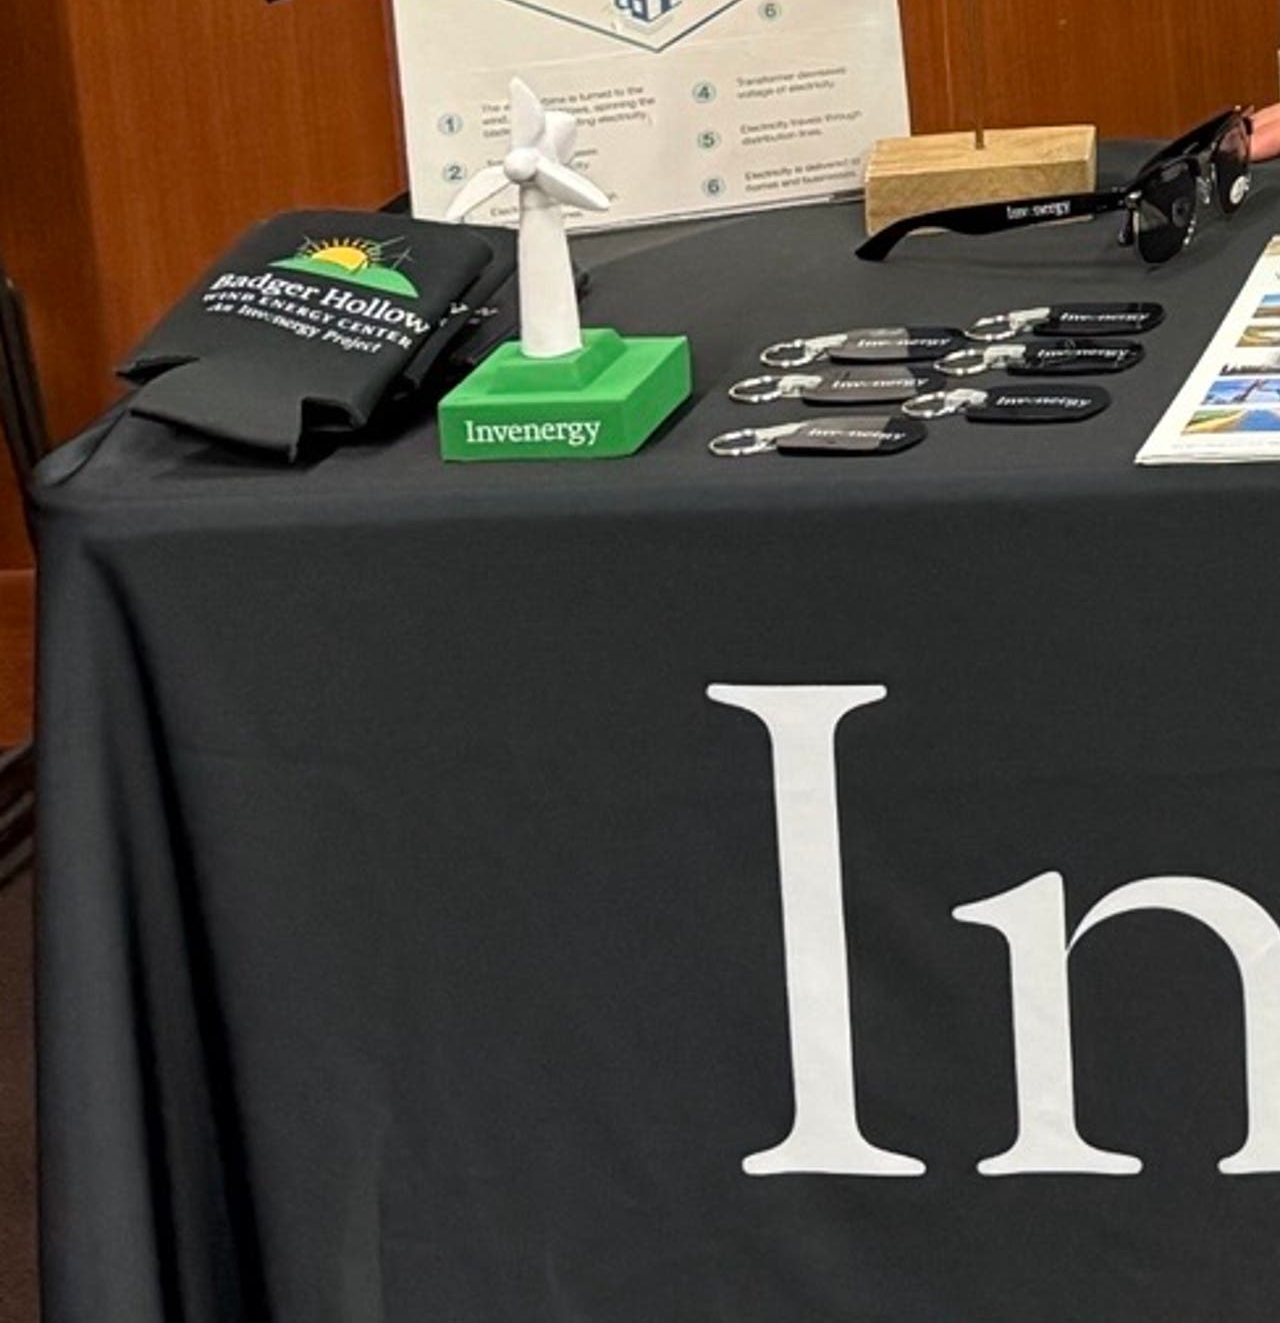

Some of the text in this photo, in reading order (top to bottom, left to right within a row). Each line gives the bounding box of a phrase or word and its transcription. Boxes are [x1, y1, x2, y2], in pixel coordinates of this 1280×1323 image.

[1006, 200, 1071, 220] Invnergy
[203, 291, 414, 350] WIND ENERGY CENTER
[209, 272, 431, 334] Badger Hollow
[206, 302, 233, 312] An
[322, 329, 383, 353] Project
[1037, 347, 1130, 360] Invnergy
[464, 420, 601, 447] Invenergy
